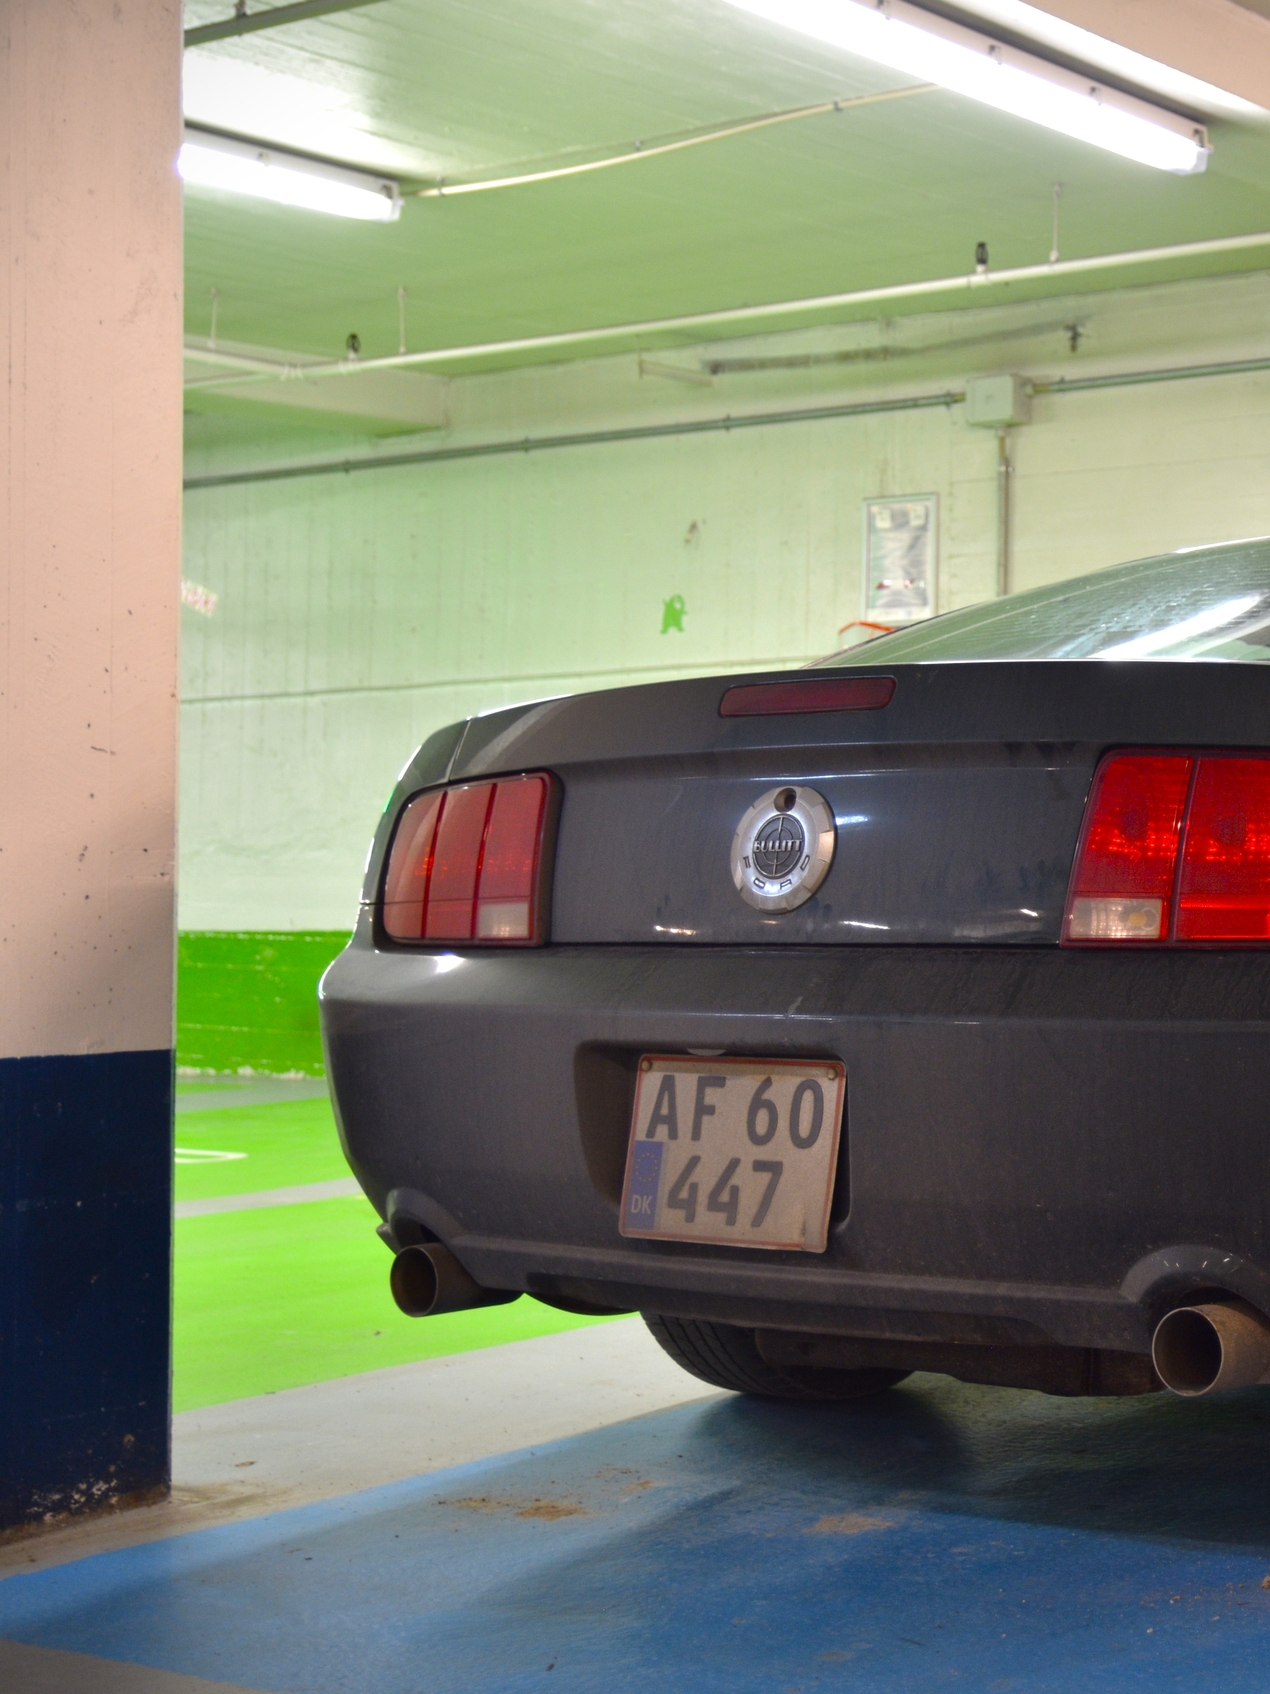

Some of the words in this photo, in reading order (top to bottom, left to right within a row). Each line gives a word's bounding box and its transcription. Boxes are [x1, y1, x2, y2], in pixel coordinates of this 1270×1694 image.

[753, 839, 802, 853] BULLITT
[644, 1074, 727, 1142] AF
[746, 1076, 824, 1150] 60
[631, 1194, 652, 1214] DK
[667, 1155, 783, 1228] 447
